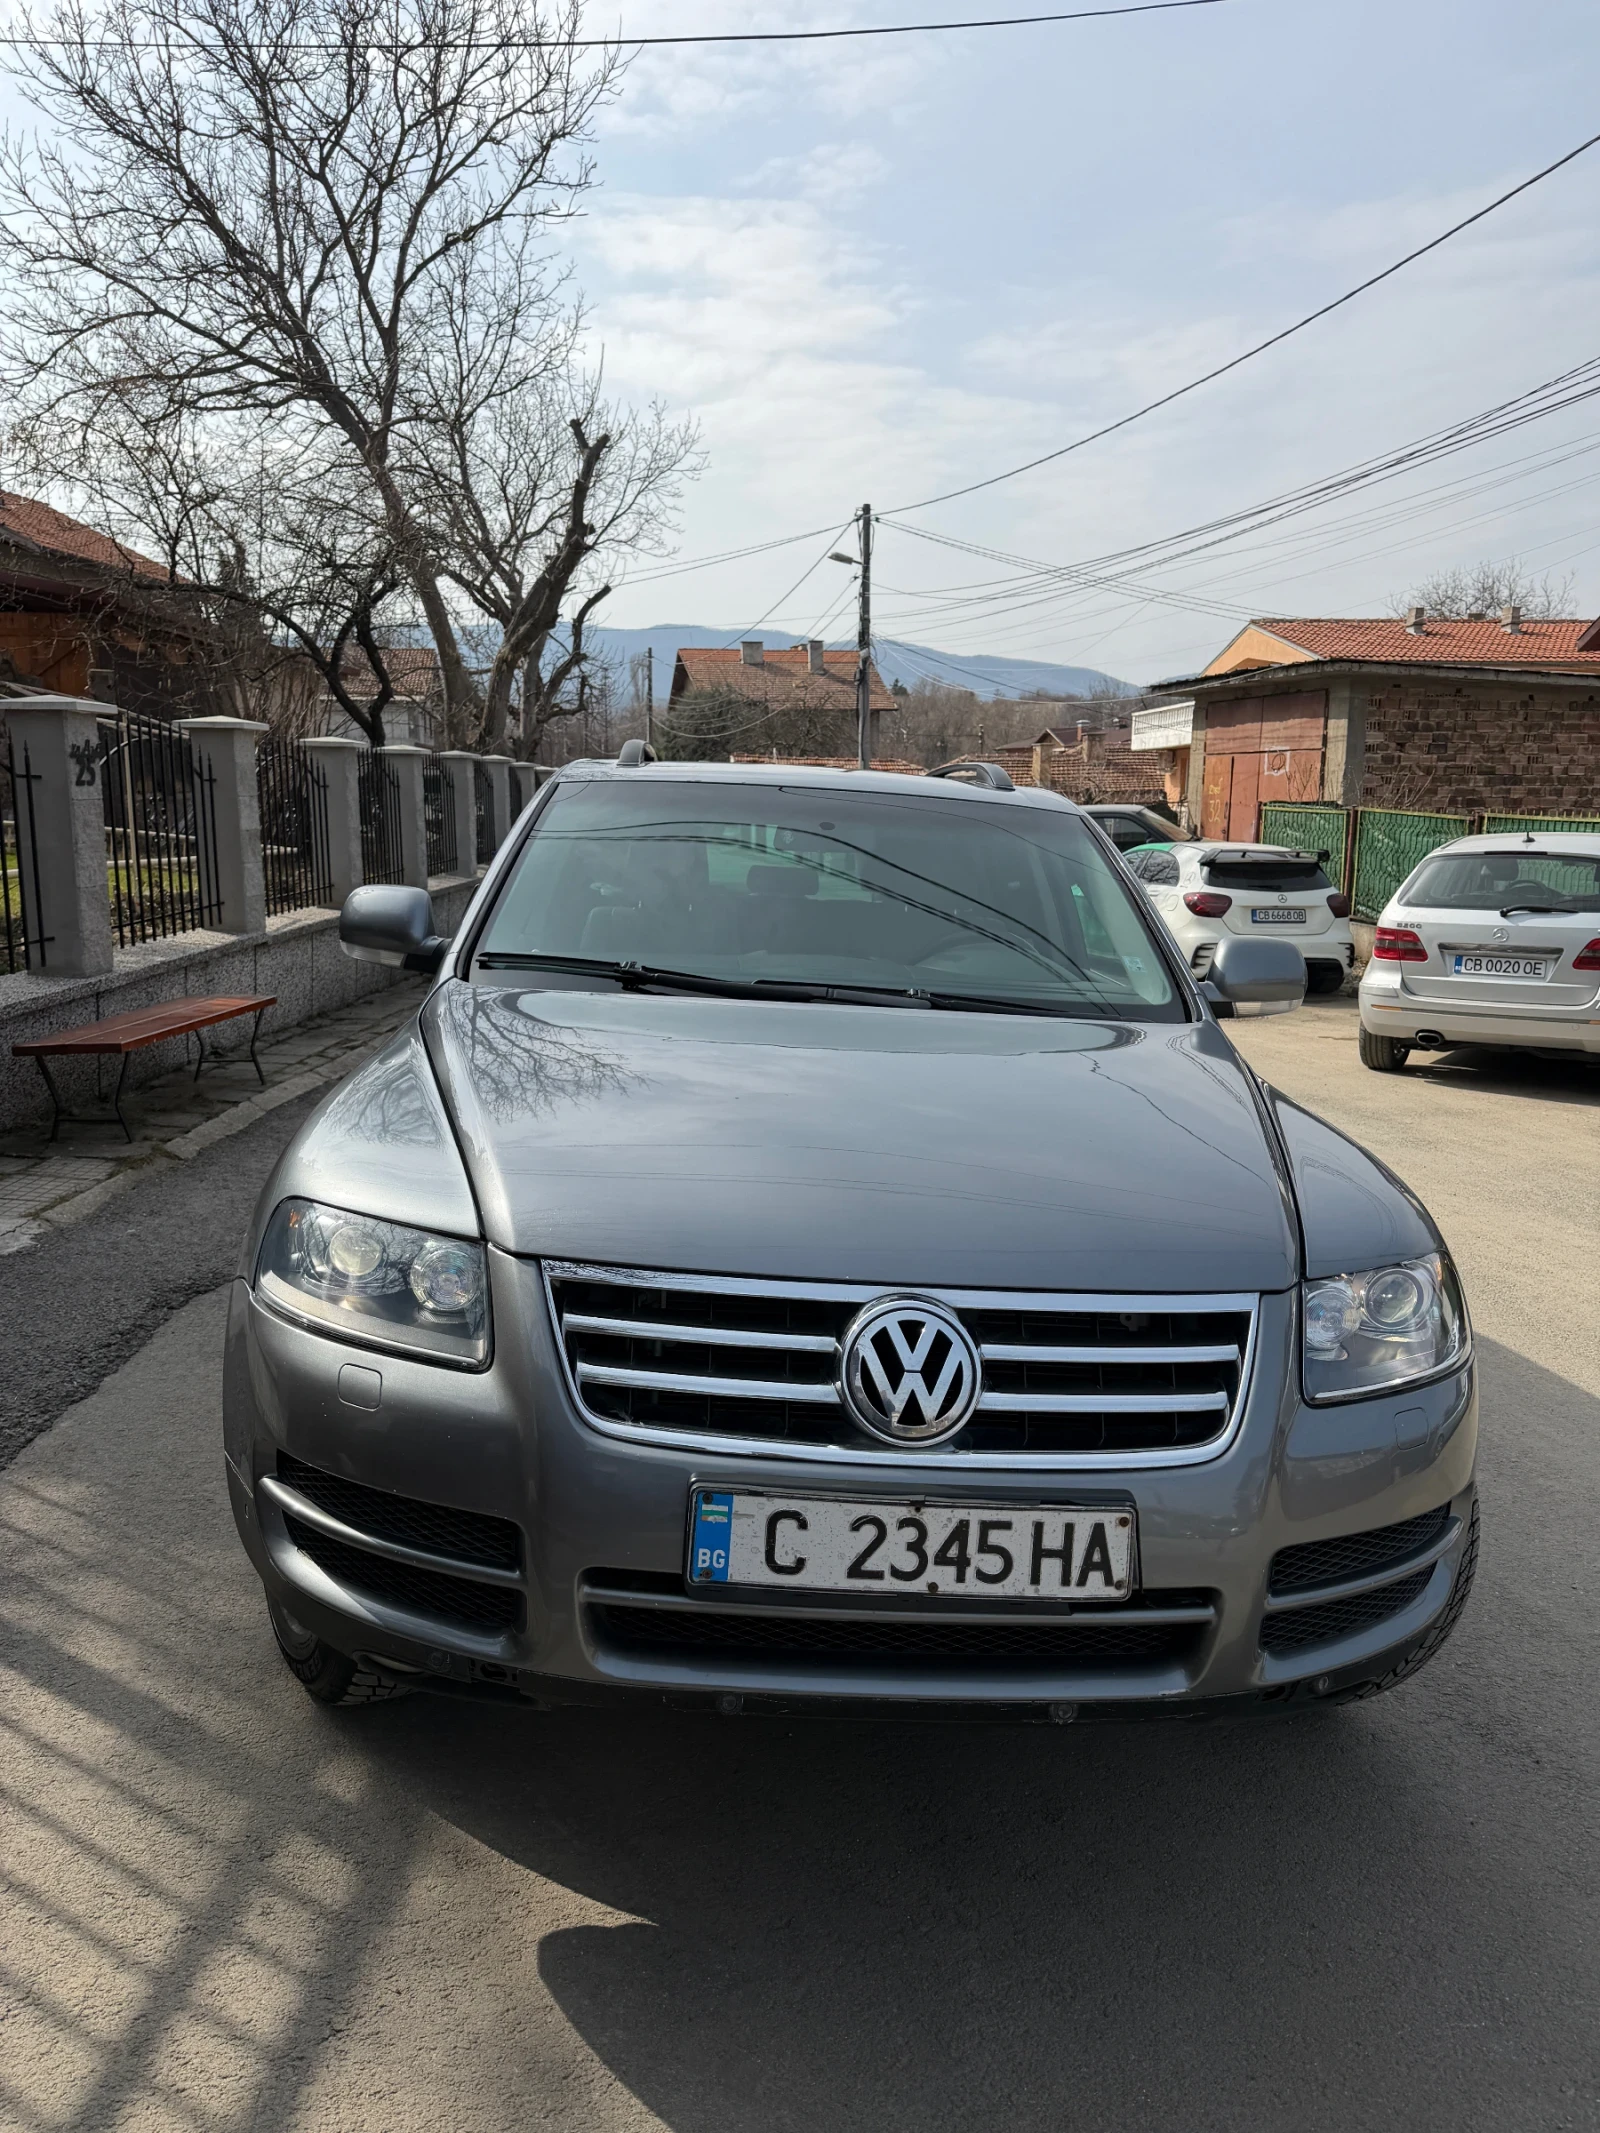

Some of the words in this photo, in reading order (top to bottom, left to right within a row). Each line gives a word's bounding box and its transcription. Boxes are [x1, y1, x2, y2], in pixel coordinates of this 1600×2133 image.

[1208, 799, 1221, 823] 32
[1258, 910, 1270, 920] CB
[1271, 910, 1292, 920] 6668
[1464, 958, 1482, 972] CB
[1485, 959, 1520, 974] 0020
[1523, 961, 1542, 976] OE
[852, 1312, 969, 1430] VW
[697, 1548, 726, 1568] BG
[765, 1508, 809, 1575] C
[846, 1514, 1014, 1584] 2345
[1030, 1521, 1114, 1587] HA
